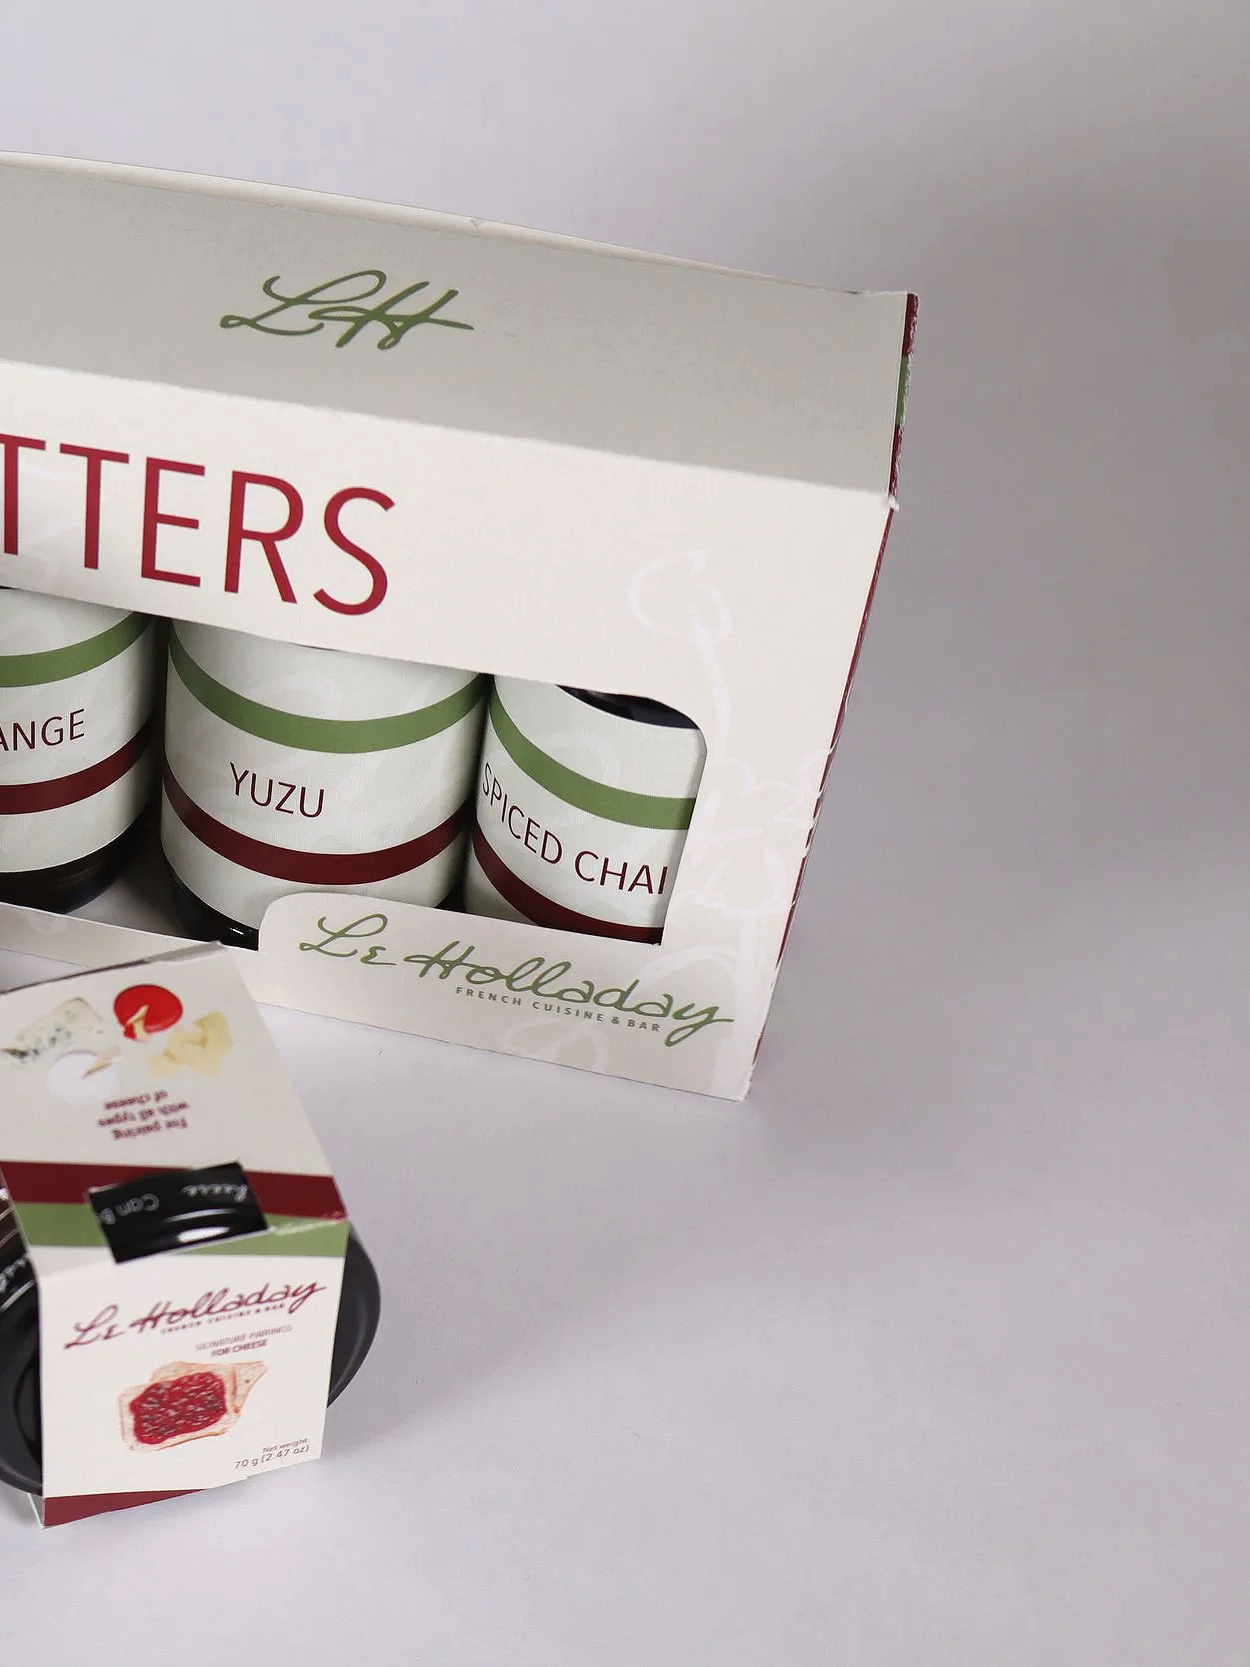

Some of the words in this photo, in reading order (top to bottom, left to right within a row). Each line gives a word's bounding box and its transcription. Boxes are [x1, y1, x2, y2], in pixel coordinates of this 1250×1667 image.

[229, 762, 325, 818] YUZU
[482, 762, 563, 864] SPICED
[574, 850, 668, 895] CHAI
[403, 940, 735, 1048] Holladay
[455, 986, 522, 1005] FRENCH
[532, 1001, 603, 1022] CUISINE
[611, 1016, 620, 1025] &
[628, 1019, 661, 1032] BAR
[129, 1281, 327, 1333] Holladay
[234, 1459, 249, 1469] 70
